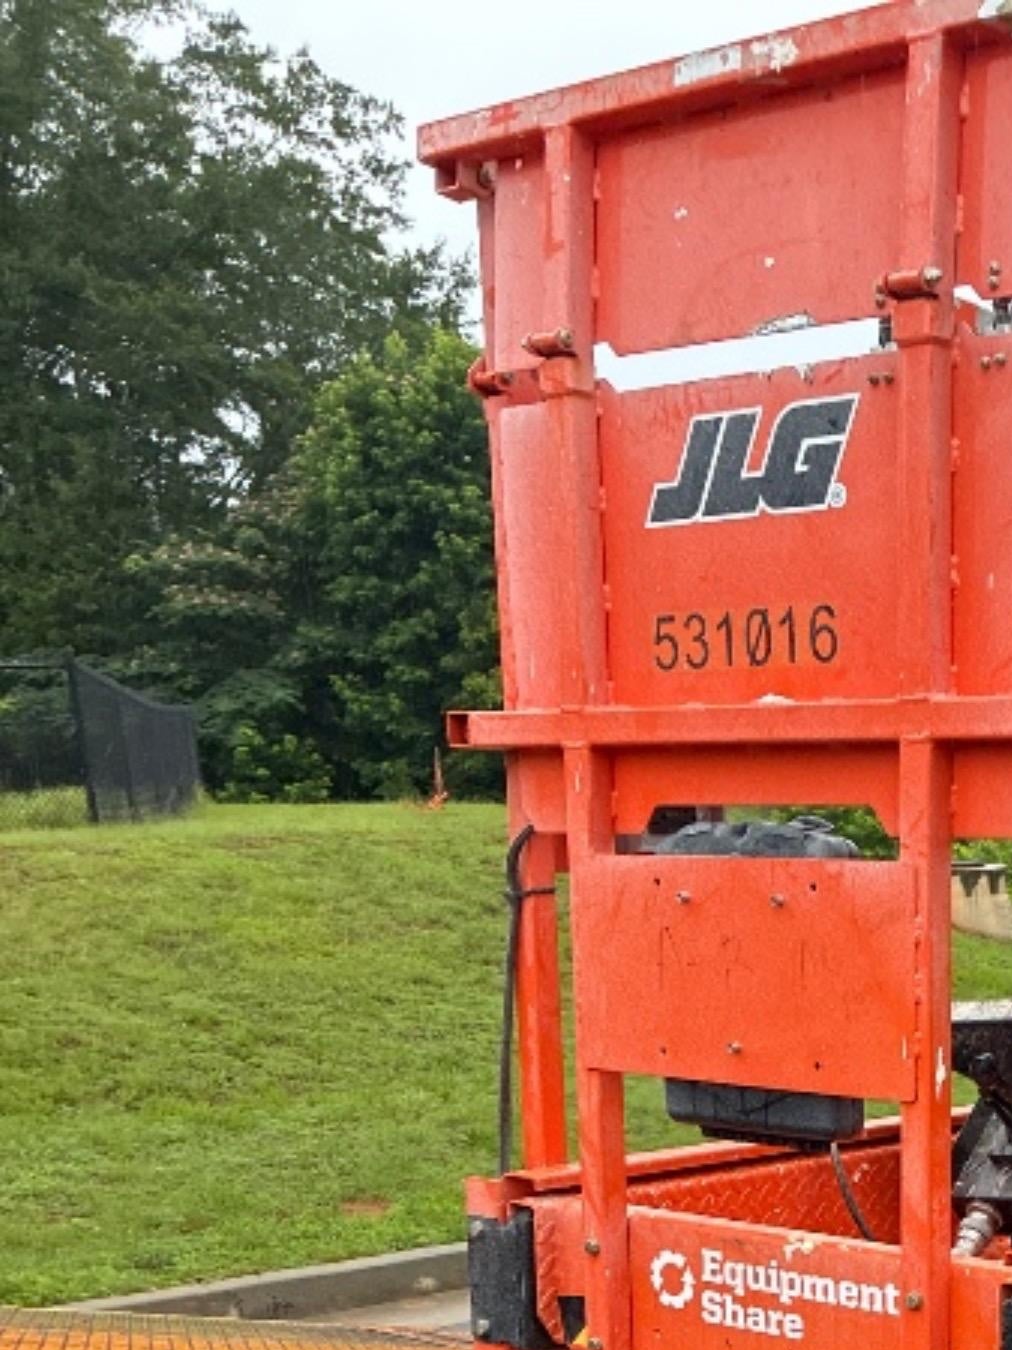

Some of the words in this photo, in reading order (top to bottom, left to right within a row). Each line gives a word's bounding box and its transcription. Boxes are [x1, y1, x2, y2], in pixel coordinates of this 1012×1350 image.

[645, 392, 861, 528] JLG
[654, 604, 839, 671] 531016
[700, 1247, 900, 1316] Equipment
[700, 1288, 805, 1340] Share
